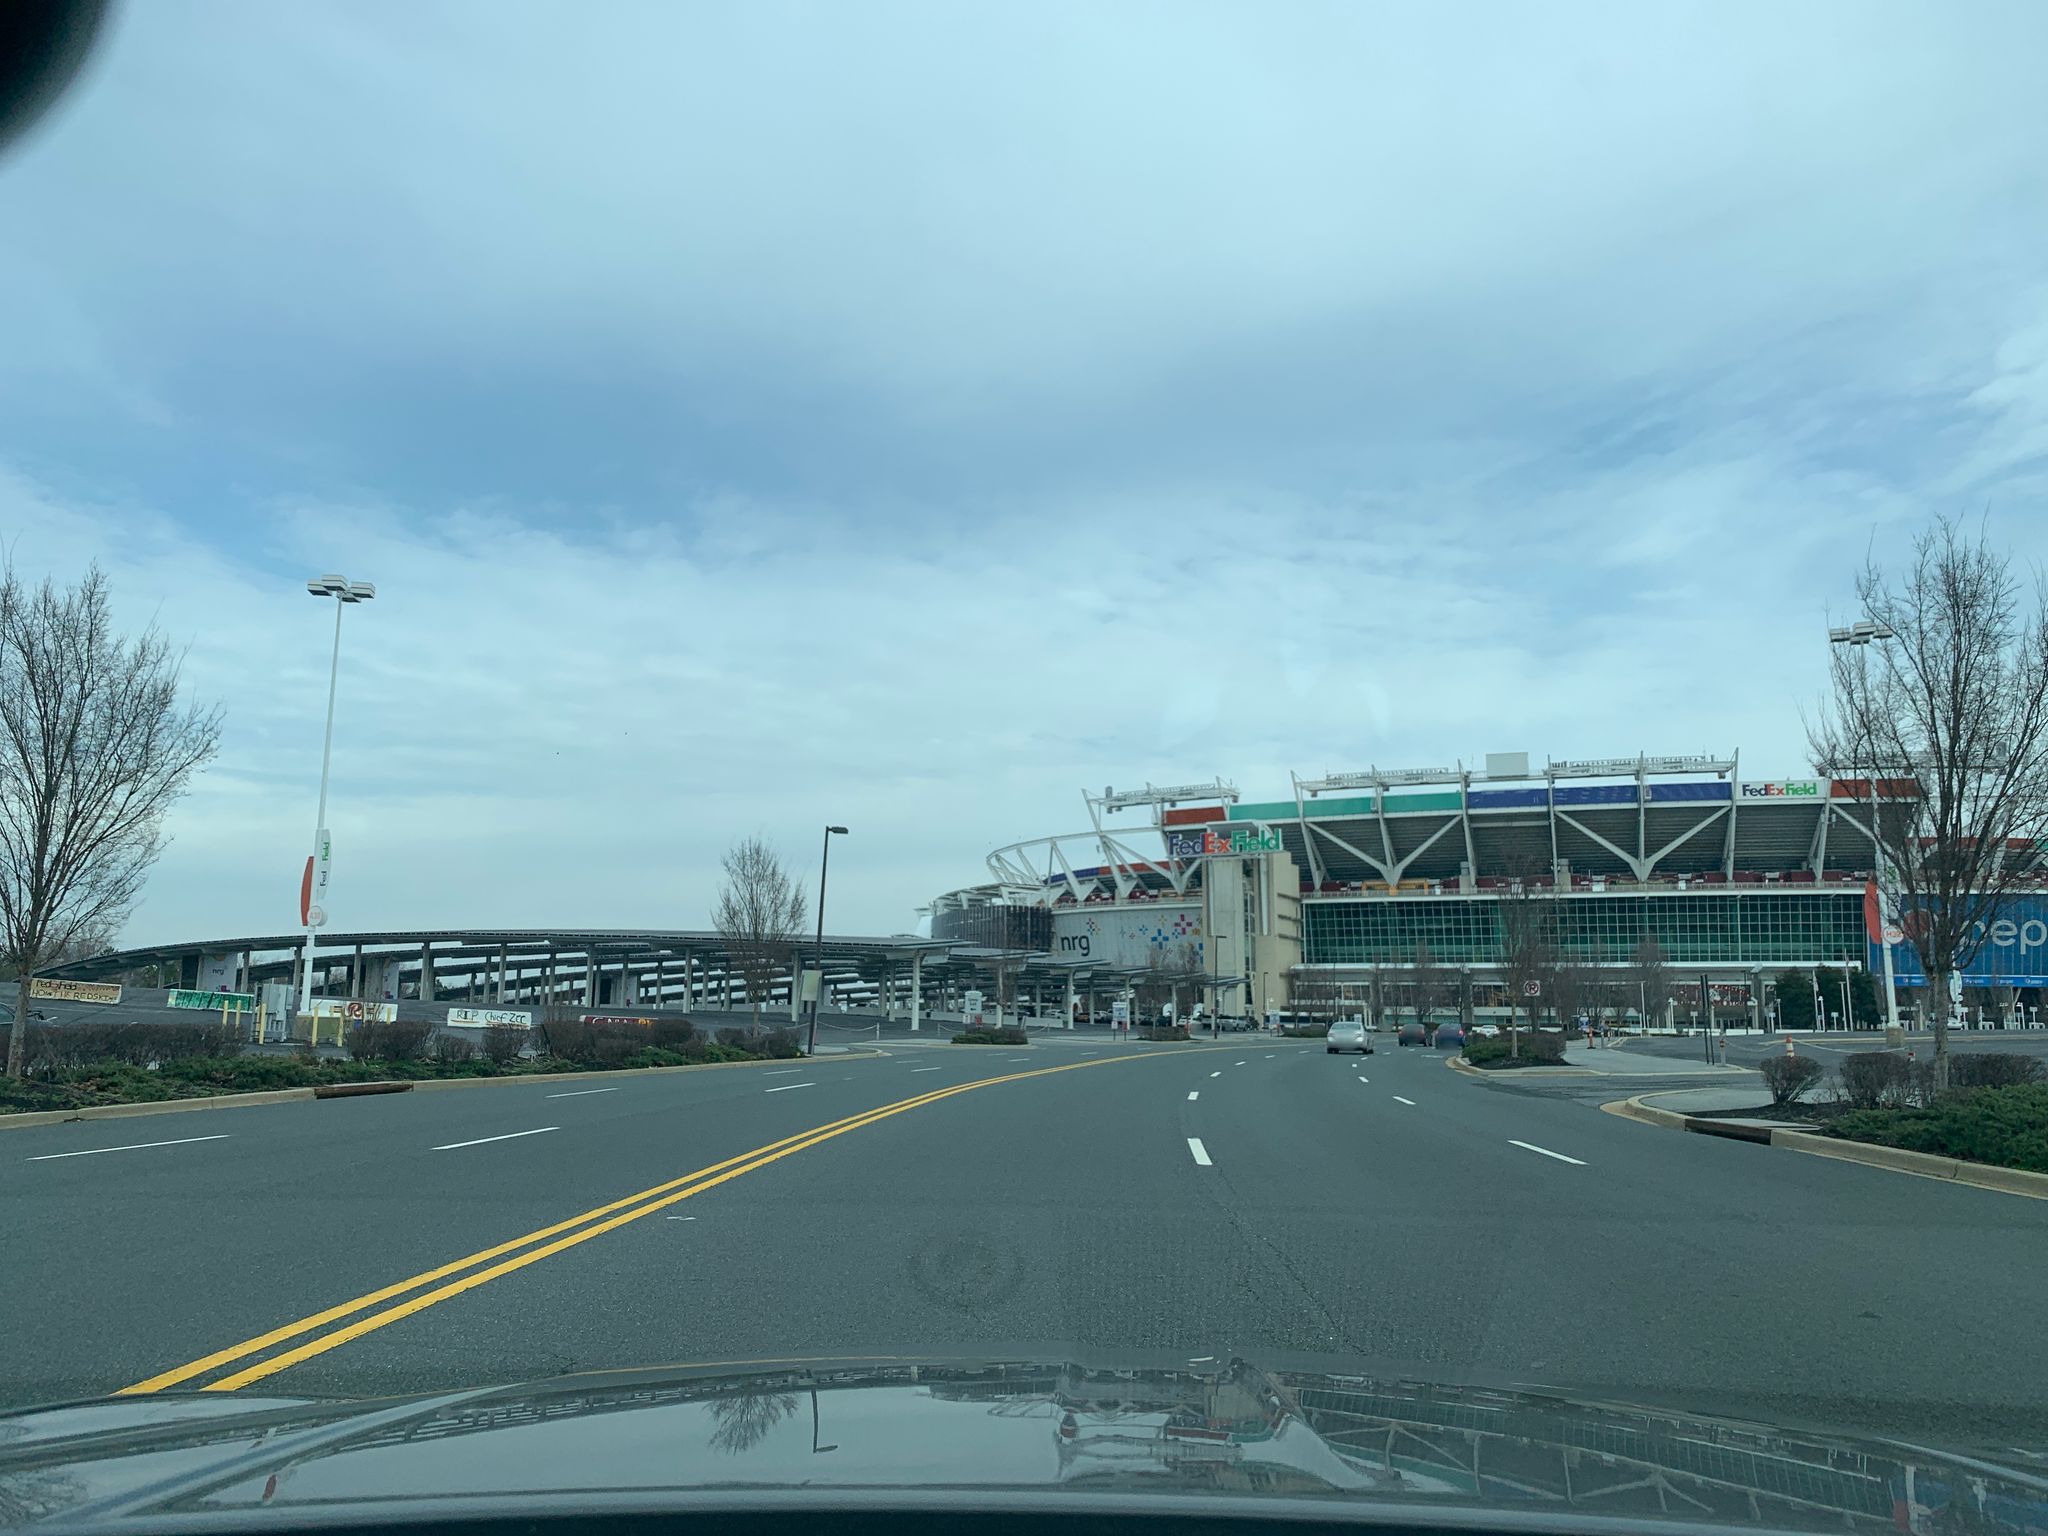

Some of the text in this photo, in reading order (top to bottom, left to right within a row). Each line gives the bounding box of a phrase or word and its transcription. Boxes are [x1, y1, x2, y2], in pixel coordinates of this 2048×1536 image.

[1741, 783, 1817, 797] FedExField
[1167, 829, 1281, 855] FedExField
[1061, 935, 1091, 957] nrg
